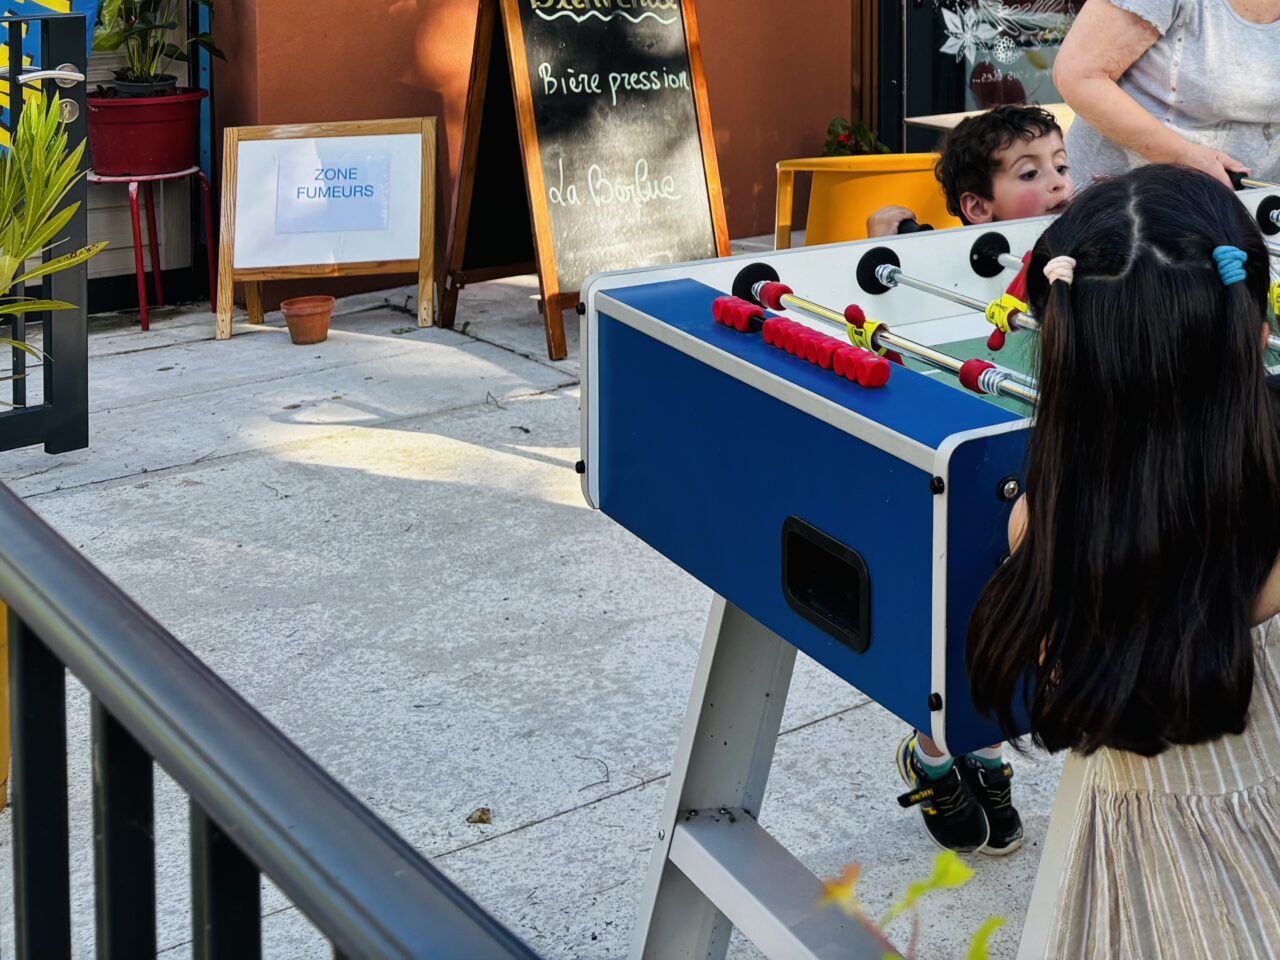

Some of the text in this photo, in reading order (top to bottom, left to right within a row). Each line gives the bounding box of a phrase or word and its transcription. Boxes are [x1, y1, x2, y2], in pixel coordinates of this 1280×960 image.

[538, 62, 690, 106] Bière pression
[314, 167, 358, 181] ZONE
[548, 158, 582, 207] La
[296, 184, 375, 199] FUMEURS
